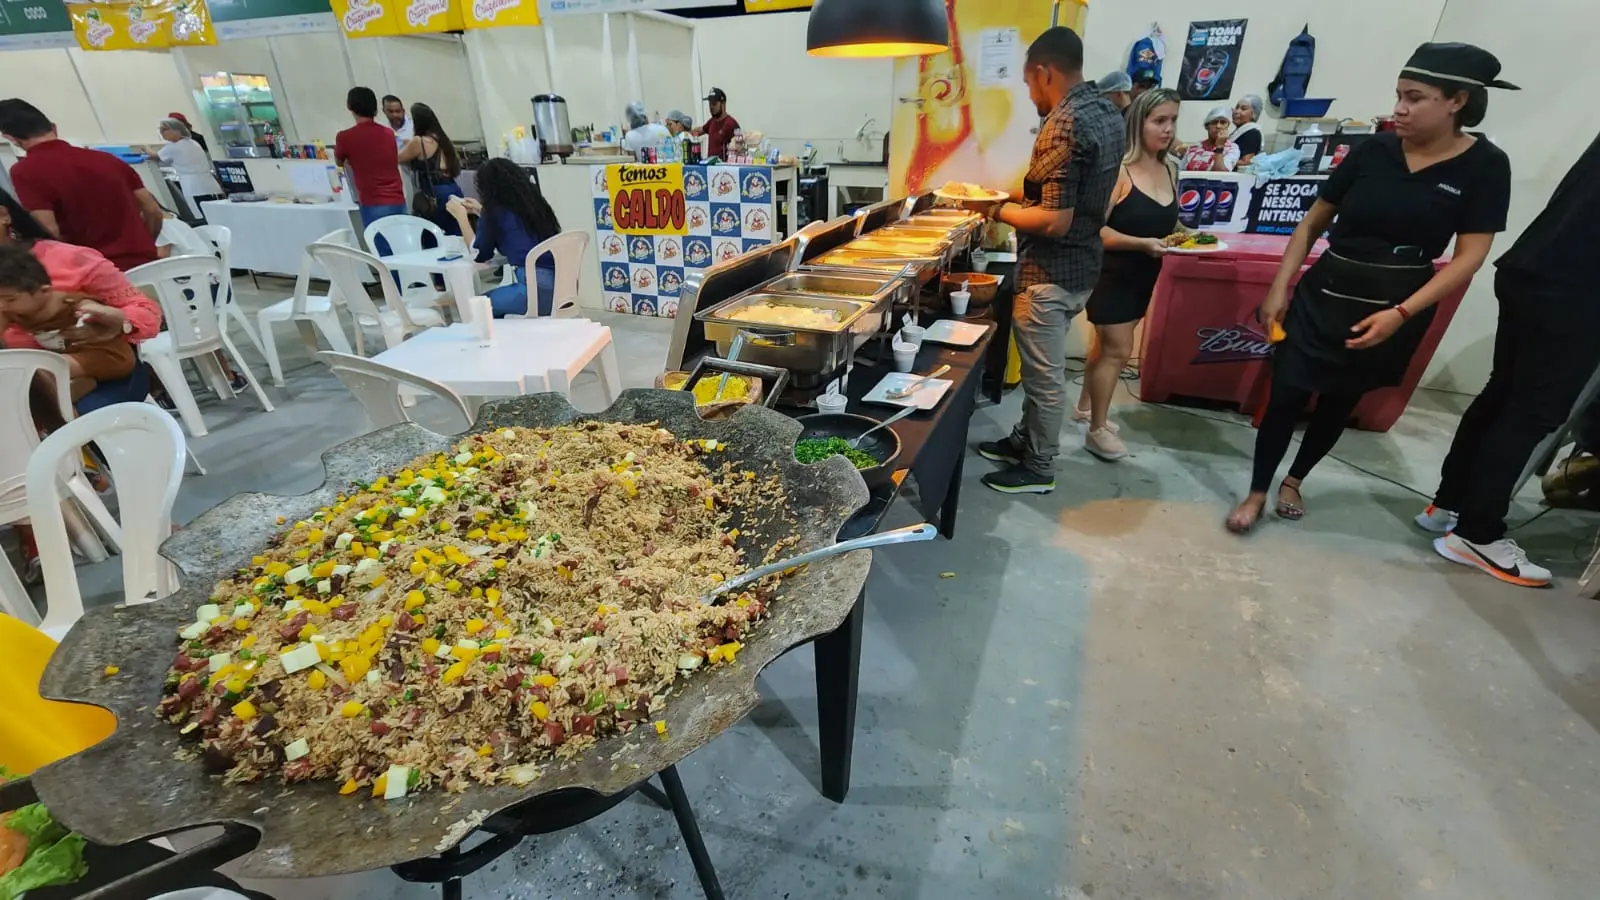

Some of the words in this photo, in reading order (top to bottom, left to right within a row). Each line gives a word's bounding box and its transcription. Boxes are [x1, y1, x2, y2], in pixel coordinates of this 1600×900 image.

[23, 7, 47, 20] COCO
[1209, 26, 1242, 36] TOMA
[1207, 35, 1236, 46] ESSA
[618, 164, 668, 183] temos
[1265, 183, 1281, 196] SE
[1282, 183, 1319, 197] JOGA
[614, 188, 686, 229] CALDO
[1261, 196, 1301, 209] NESSA
